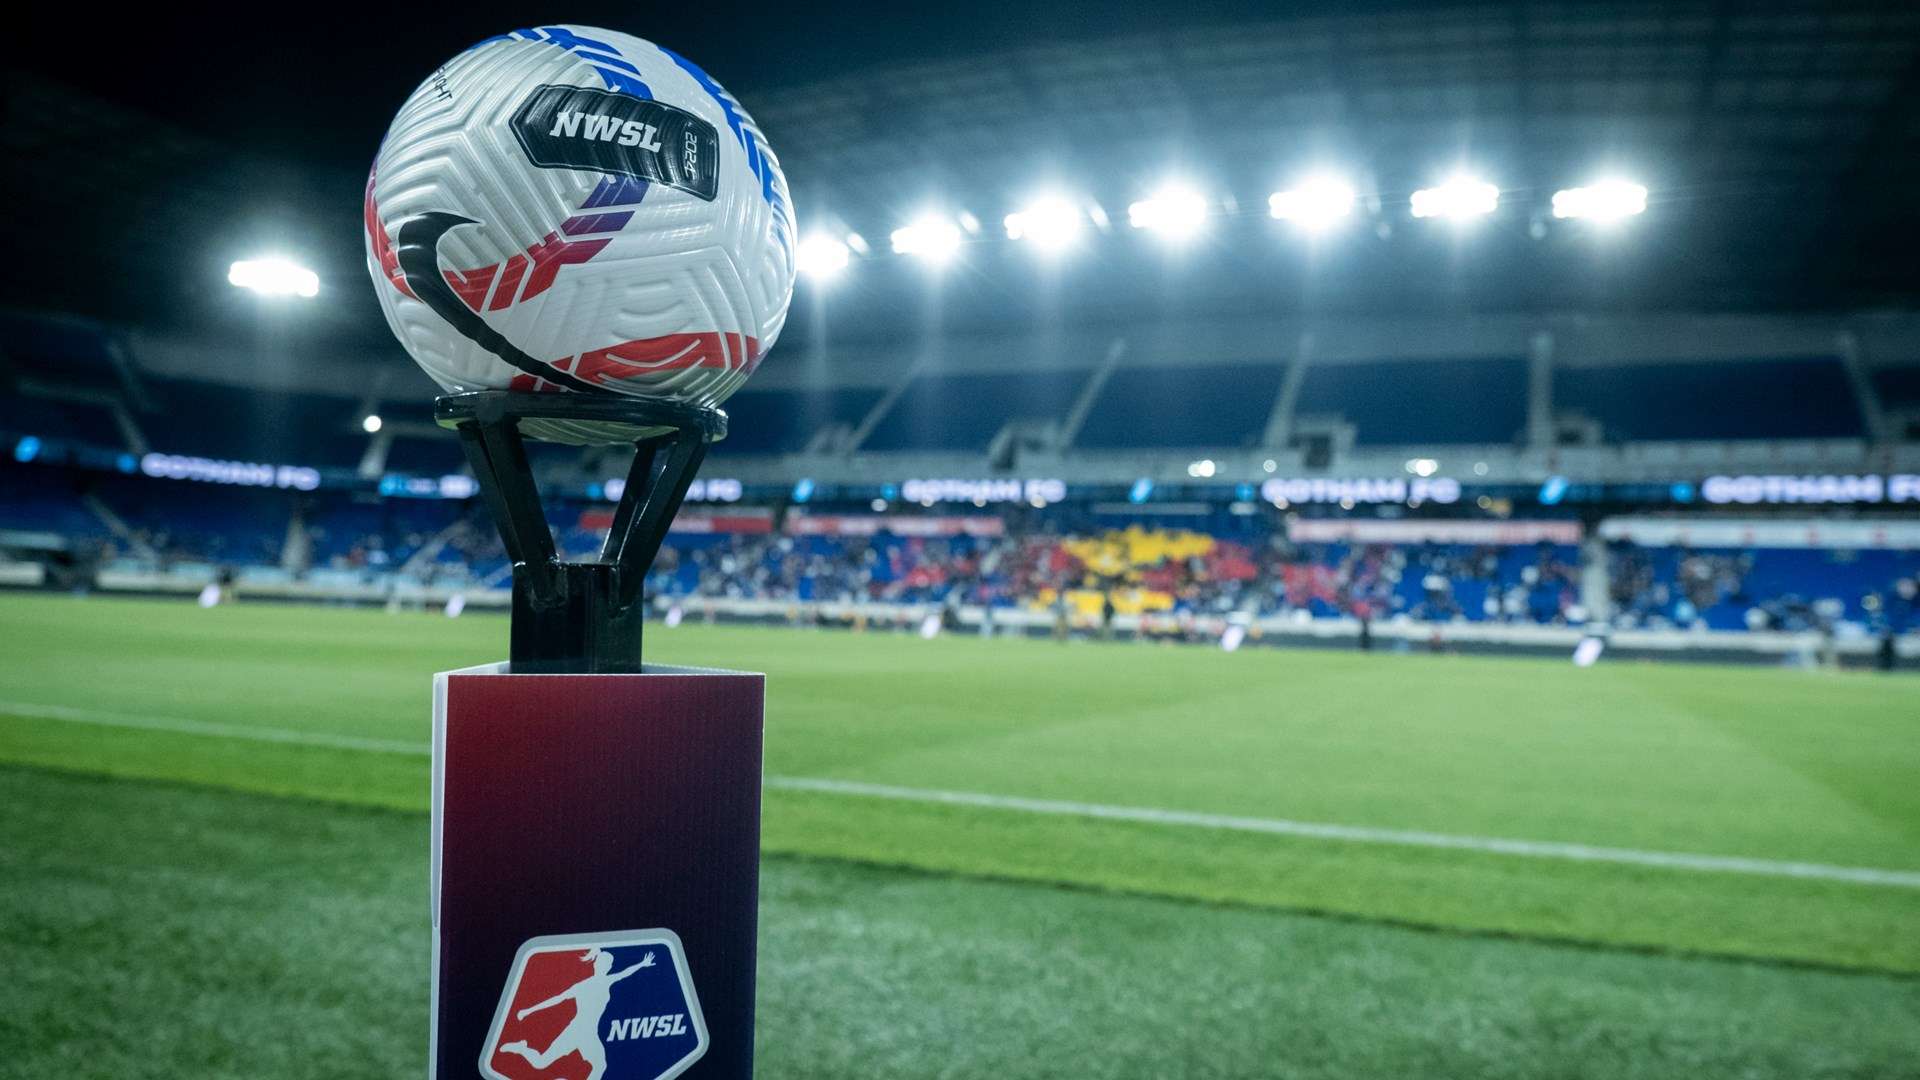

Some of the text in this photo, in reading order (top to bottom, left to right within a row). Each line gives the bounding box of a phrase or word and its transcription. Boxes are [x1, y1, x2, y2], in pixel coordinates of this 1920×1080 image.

[549, 111, 662, 153] NWSL
[684, 131, 698, 181] 2024
[1261, 478, 1407, 504] GOTHAM
[1702, 474, 1884, 504] GOTHAM
[606, 1013, 687, 1042] NWSL
